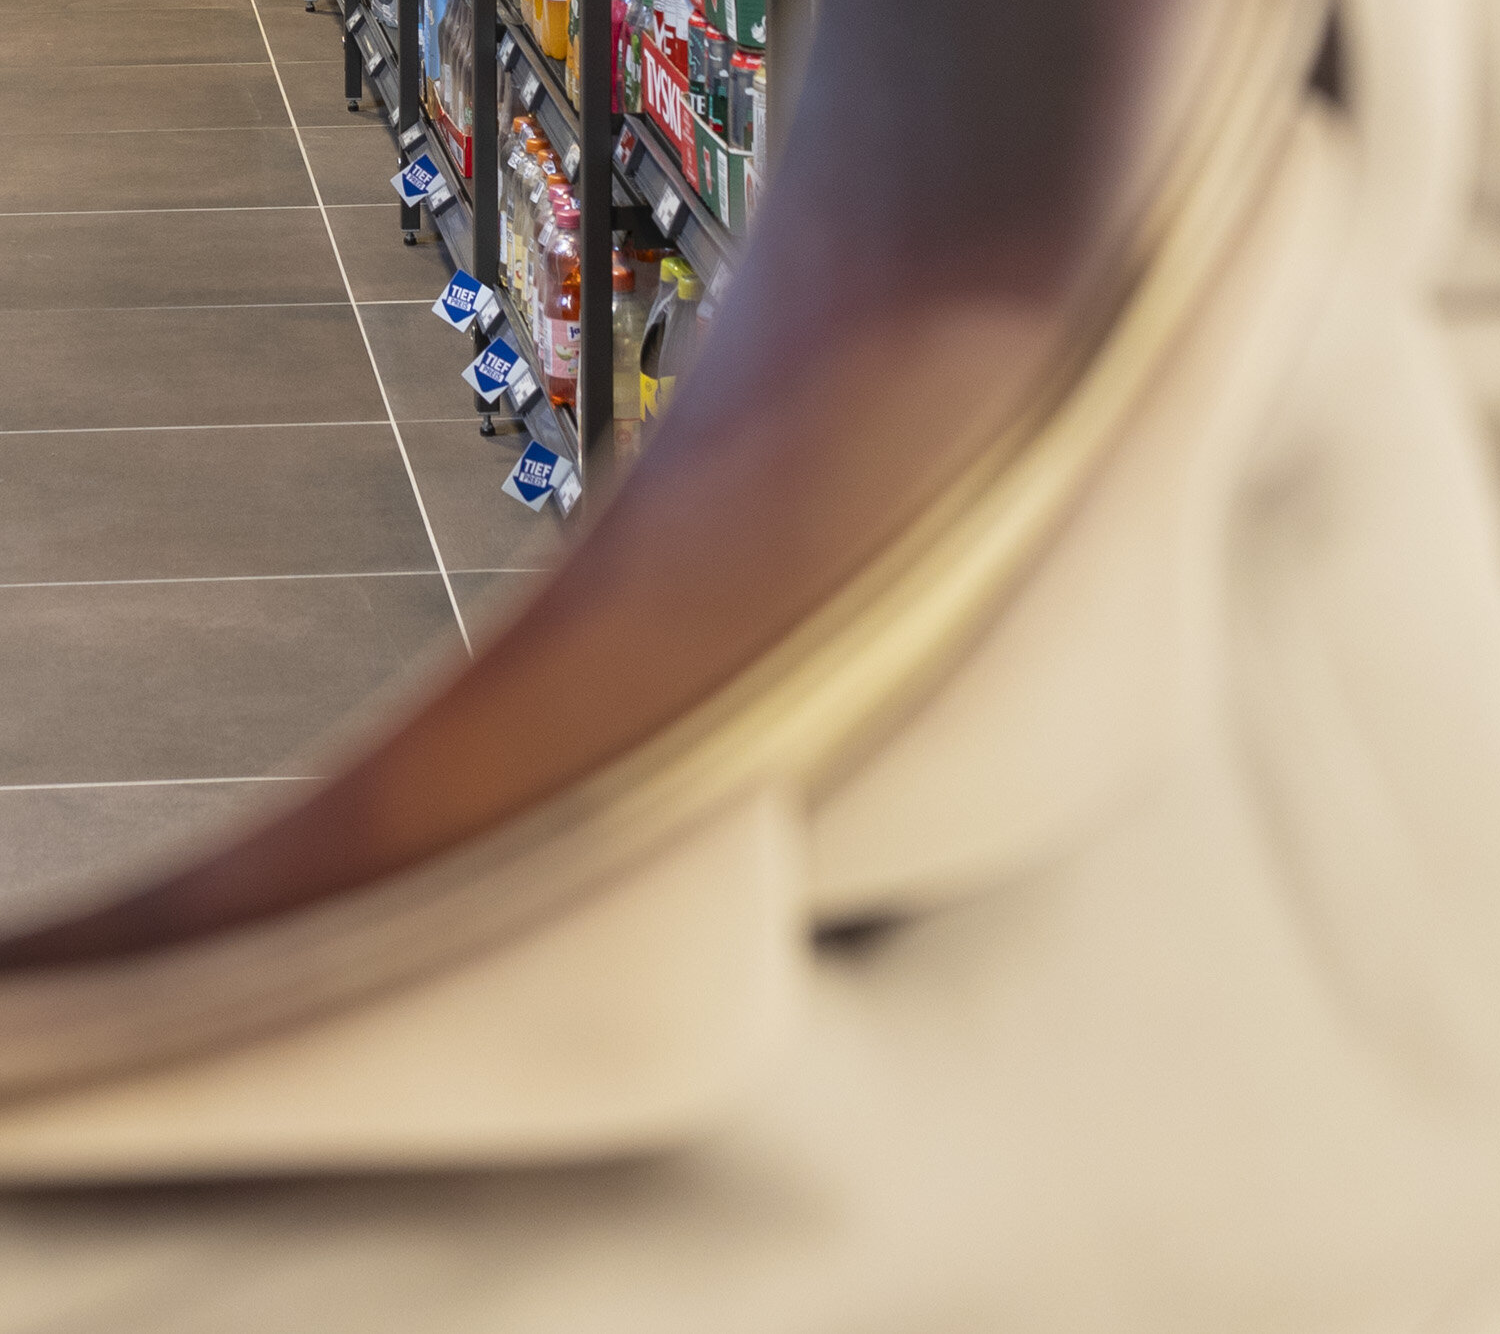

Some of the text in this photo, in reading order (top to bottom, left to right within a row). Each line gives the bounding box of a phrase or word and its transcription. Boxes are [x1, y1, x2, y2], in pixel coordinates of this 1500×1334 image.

[643, 48, 683, 143] TYSKI
[407, 174, 425, 190] PREIS
[412, 164, 433, 183] TIEF
[450, 284, 476, 302] TIEF
[485, 352, 512, 373] TIEF
[523, 459, 552, 477] TIEF
